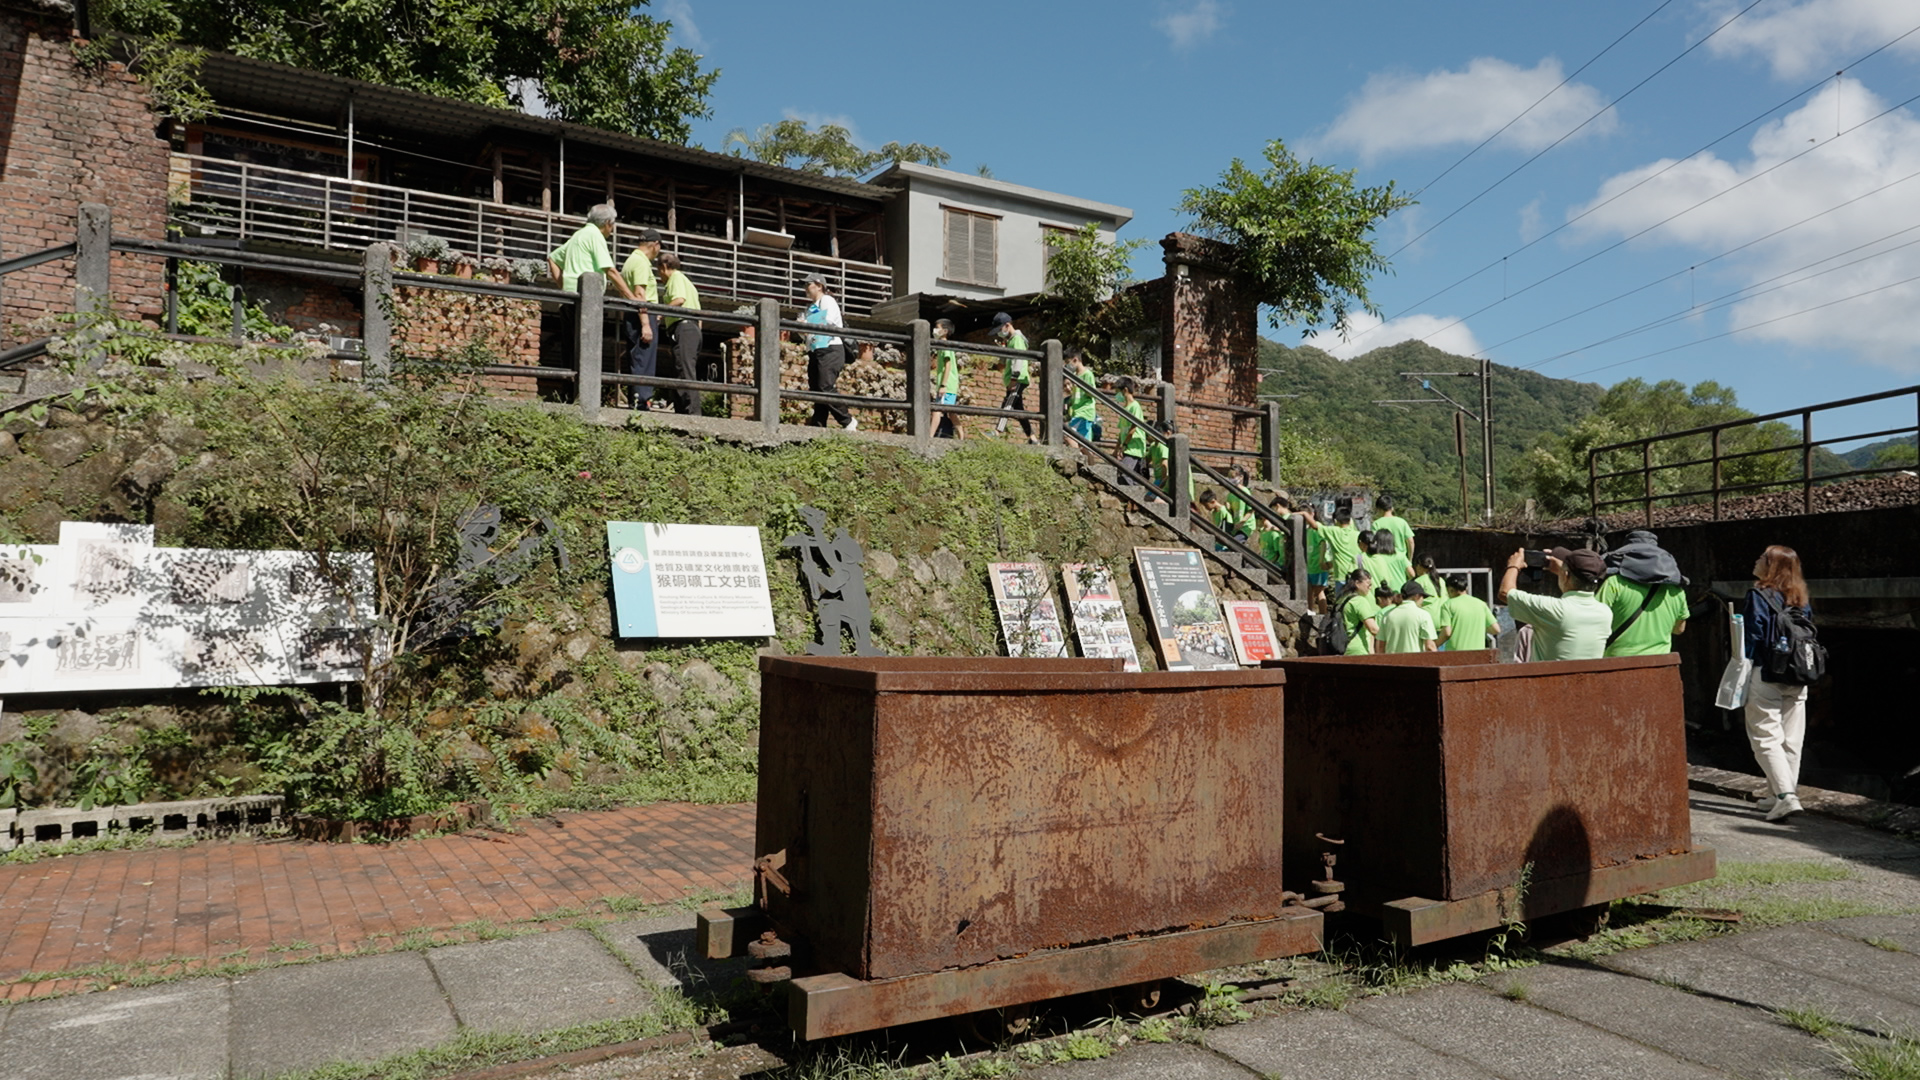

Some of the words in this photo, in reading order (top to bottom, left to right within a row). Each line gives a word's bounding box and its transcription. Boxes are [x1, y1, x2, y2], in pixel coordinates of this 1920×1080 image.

[655, 563, 760, 573] 地質及礦業文化推廣教室
[657, 574, 762, 588] 猴硐礦工文史館
